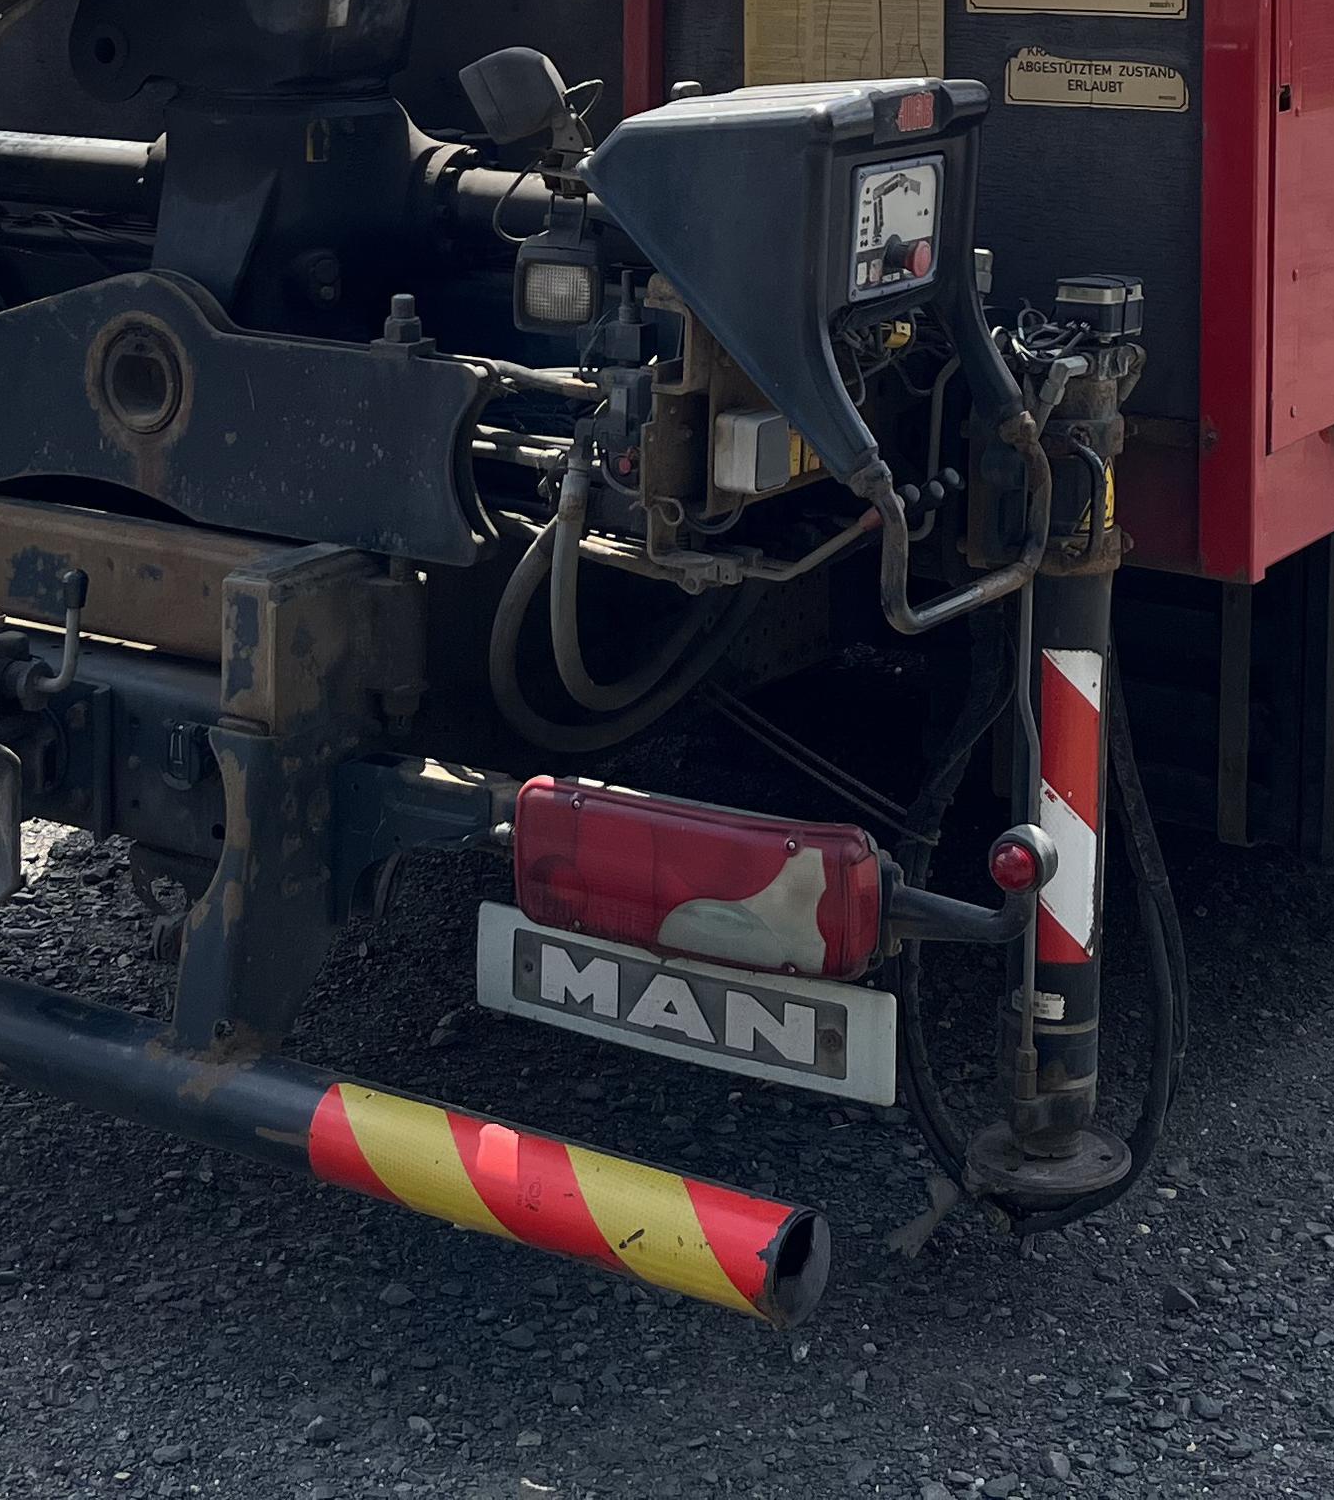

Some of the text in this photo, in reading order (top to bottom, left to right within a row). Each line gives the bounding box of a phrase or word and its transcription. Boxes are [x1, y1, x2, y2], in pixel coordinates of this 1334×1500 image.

[1017, 60, 1177, 79] ABGESTÜTZTEM ZUSTAND
[1068, 79, 1124, 93] ERLAUBT
[541, 943, 816, 1066] MAN
